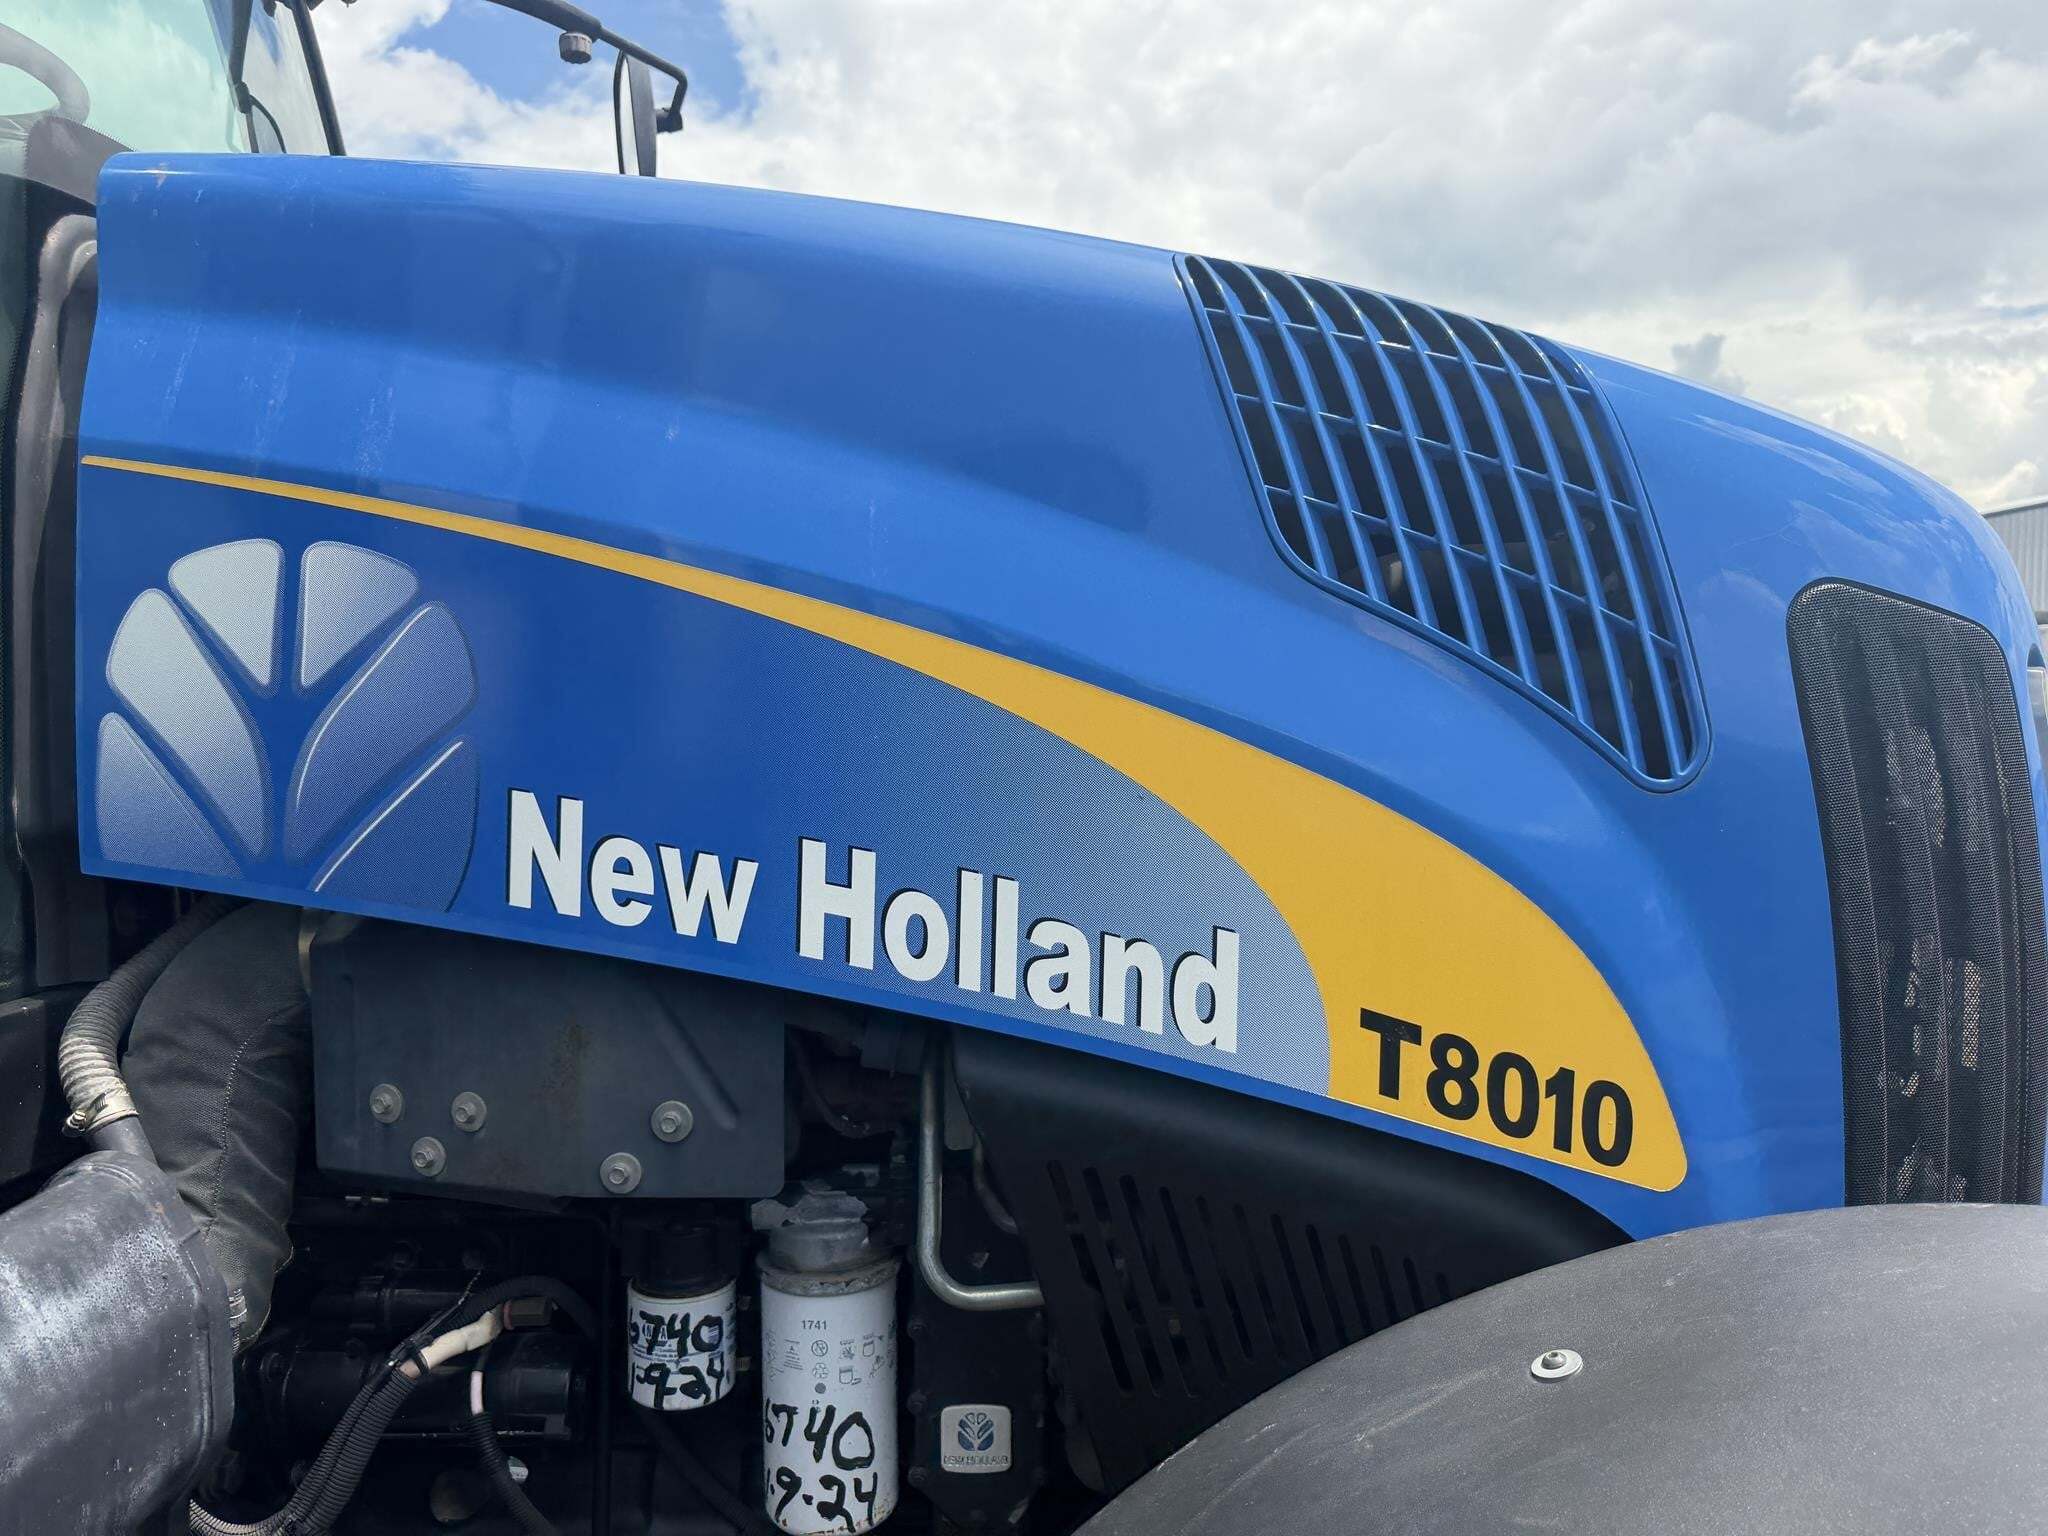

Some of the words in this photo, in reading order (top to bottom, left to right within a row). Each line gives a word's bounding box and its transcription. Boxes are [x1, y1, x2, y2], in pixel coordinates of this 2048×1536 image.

[508, 787, 759, 945] New
[797, 836, 1240, 1054] Holland
[1360, 1007, 1633, 1167] T8010
[801, 1320, 827, 1330] 1741
